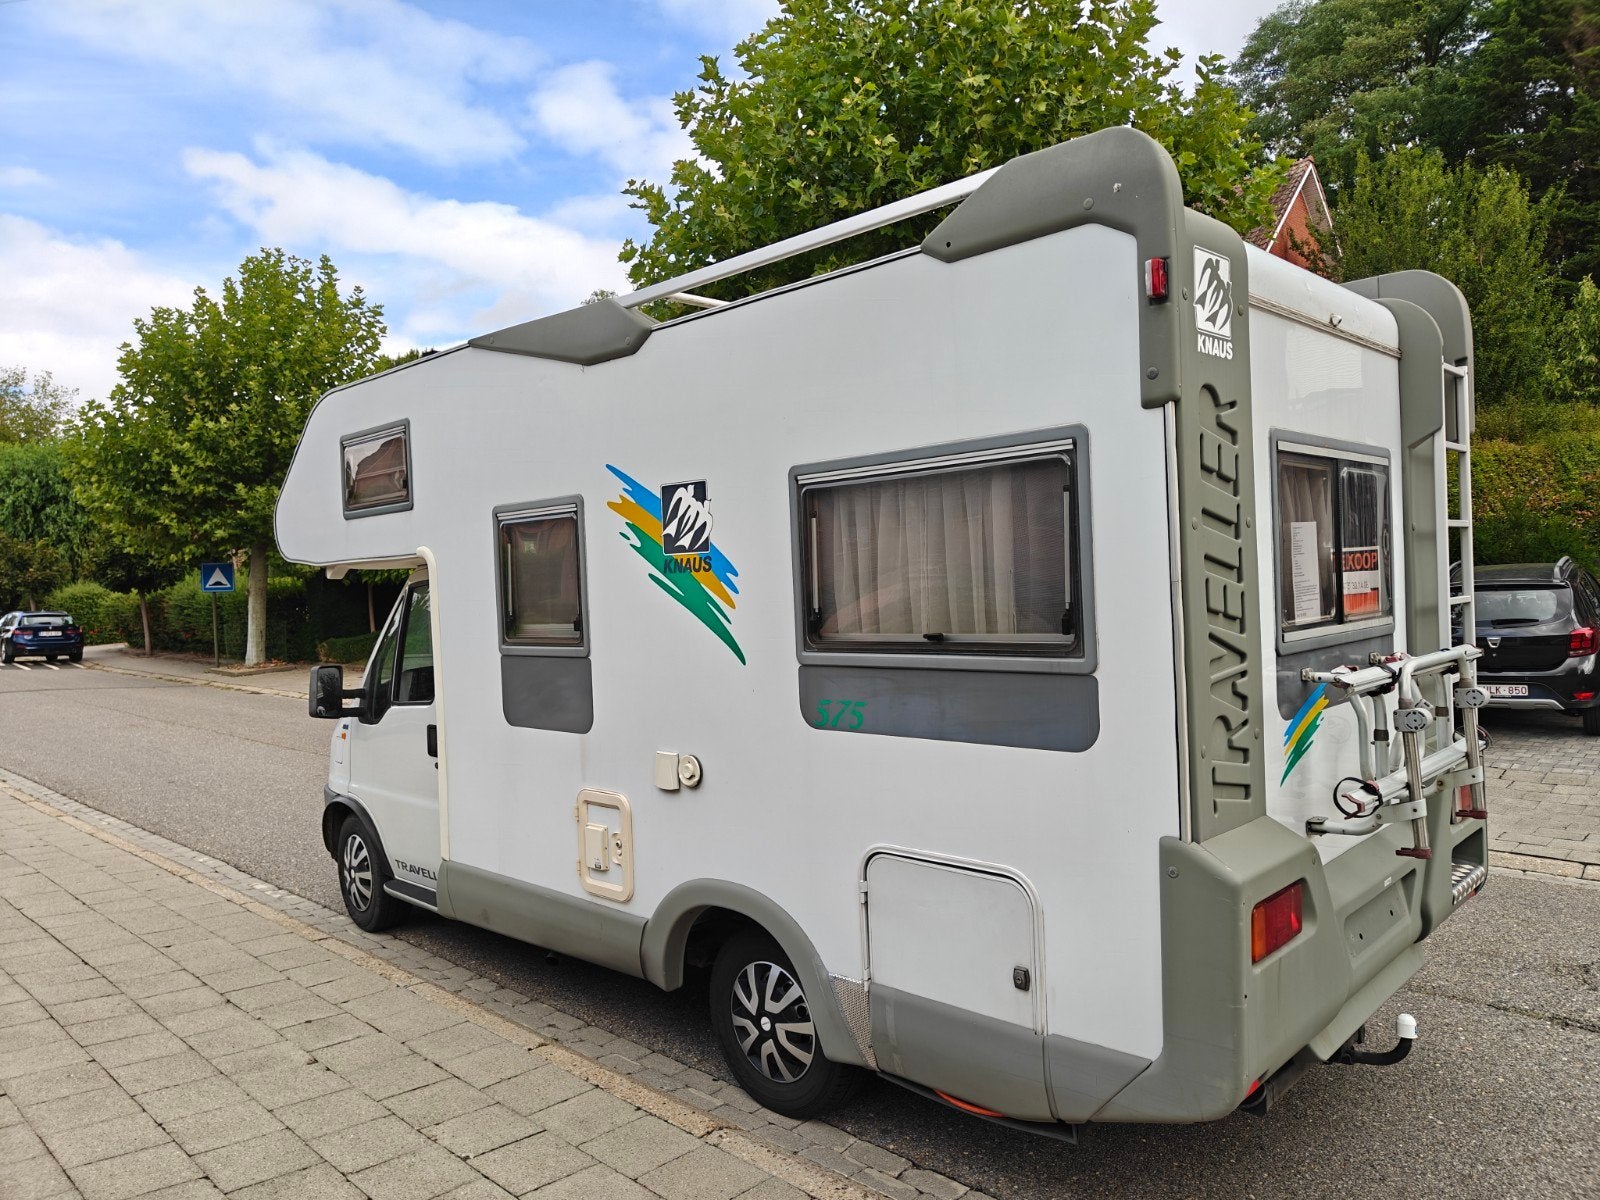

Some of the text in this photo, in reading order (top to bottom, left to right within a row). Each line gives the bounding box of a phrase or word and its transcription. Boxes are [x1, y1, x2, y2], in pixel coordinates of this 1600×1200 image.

[1197, 333, 1234, 360] KNAUS
[663, 555, 713, 574] KNAUS
[1199, 382, 1252, 817] TRAVELLER
[813, 699, 868, 730] 575
